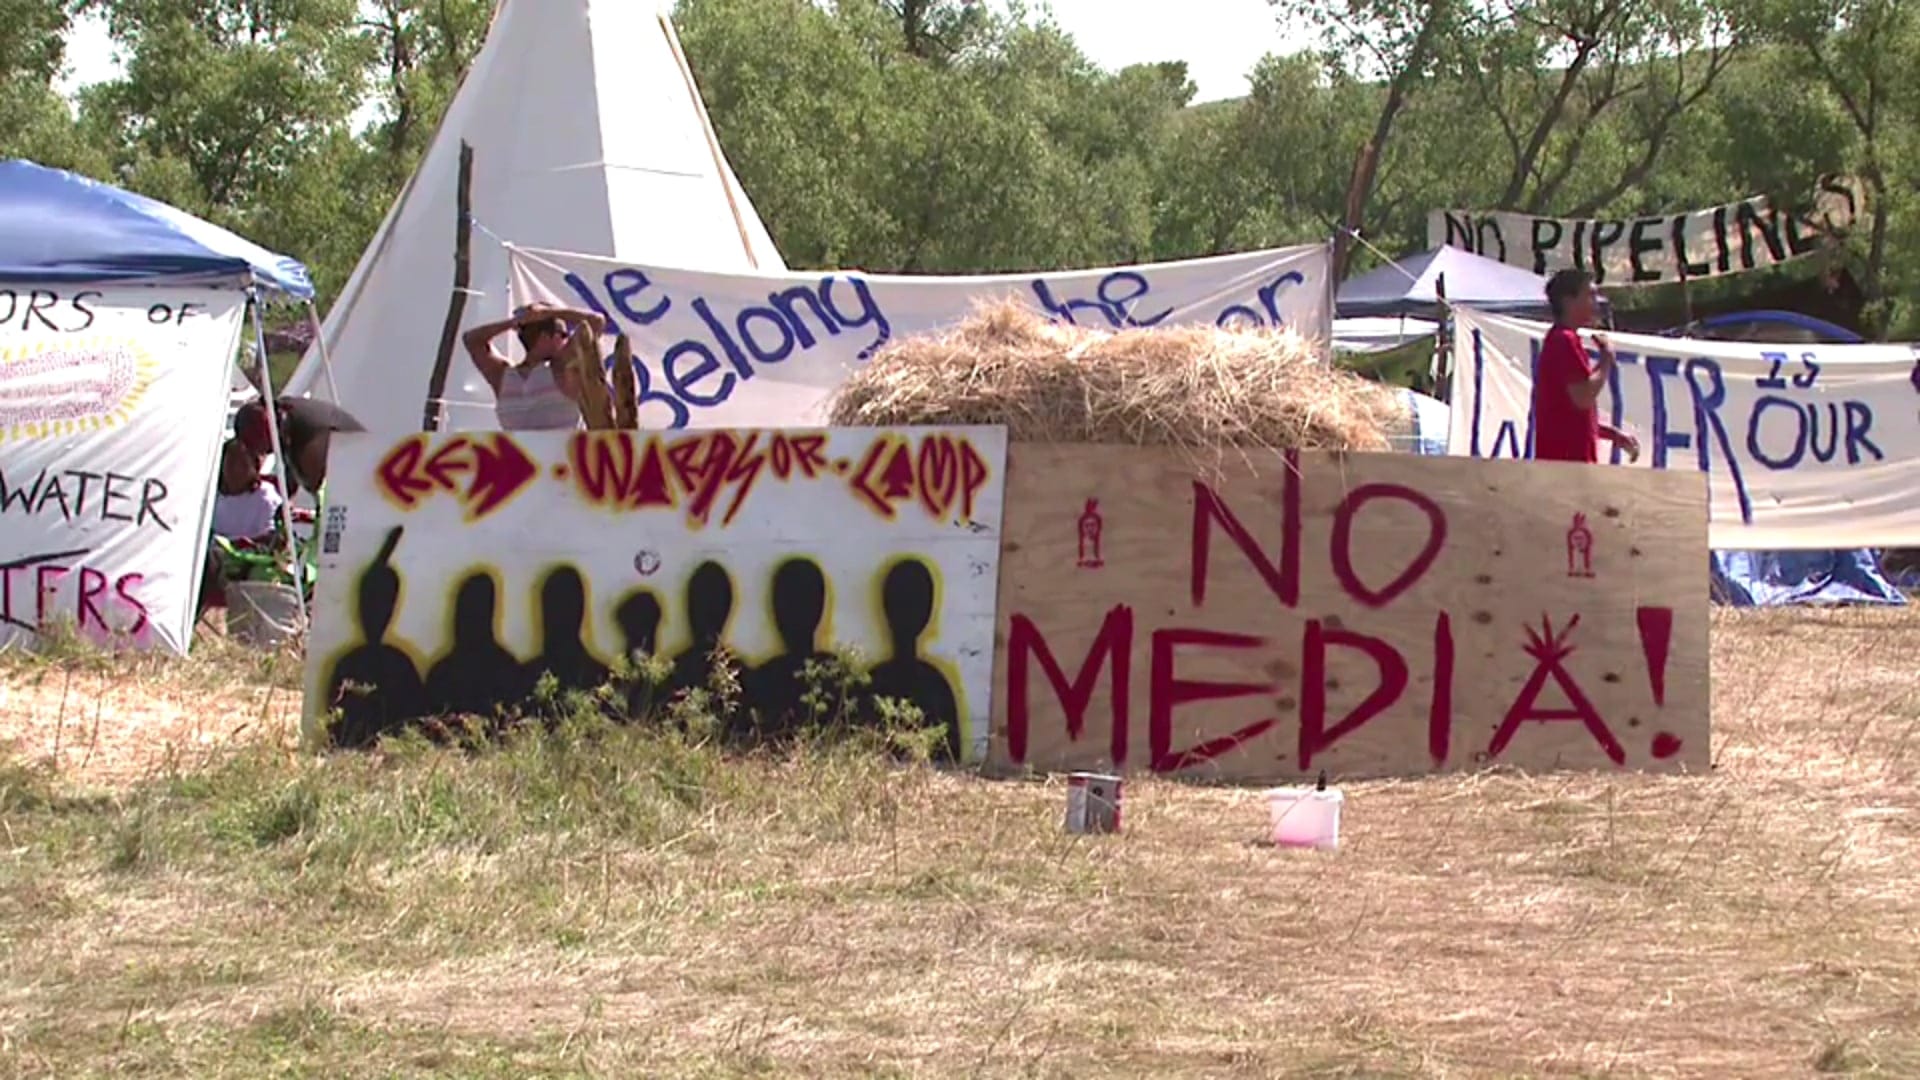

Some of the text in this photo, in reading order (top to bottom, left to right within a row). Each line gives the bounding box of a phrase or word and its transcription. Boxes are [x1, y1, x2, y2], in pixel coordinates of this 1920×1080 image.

[1444, 211, 1506, 263] NO
[147, 303, 206, 327] OF
[1755, 351, 1821, 390] IS
[1471, 328, 1753, 525] WTER
[1746, 394, 1884, 470] OUR
[0, 468, 173, 533] WATER
[377, 432, 539, 520] RED
[850, 434, 989, 519] CAMP
[1190, 448, 1446, 609] NO
[1007, 603, 1684, 772] MEDIA!
